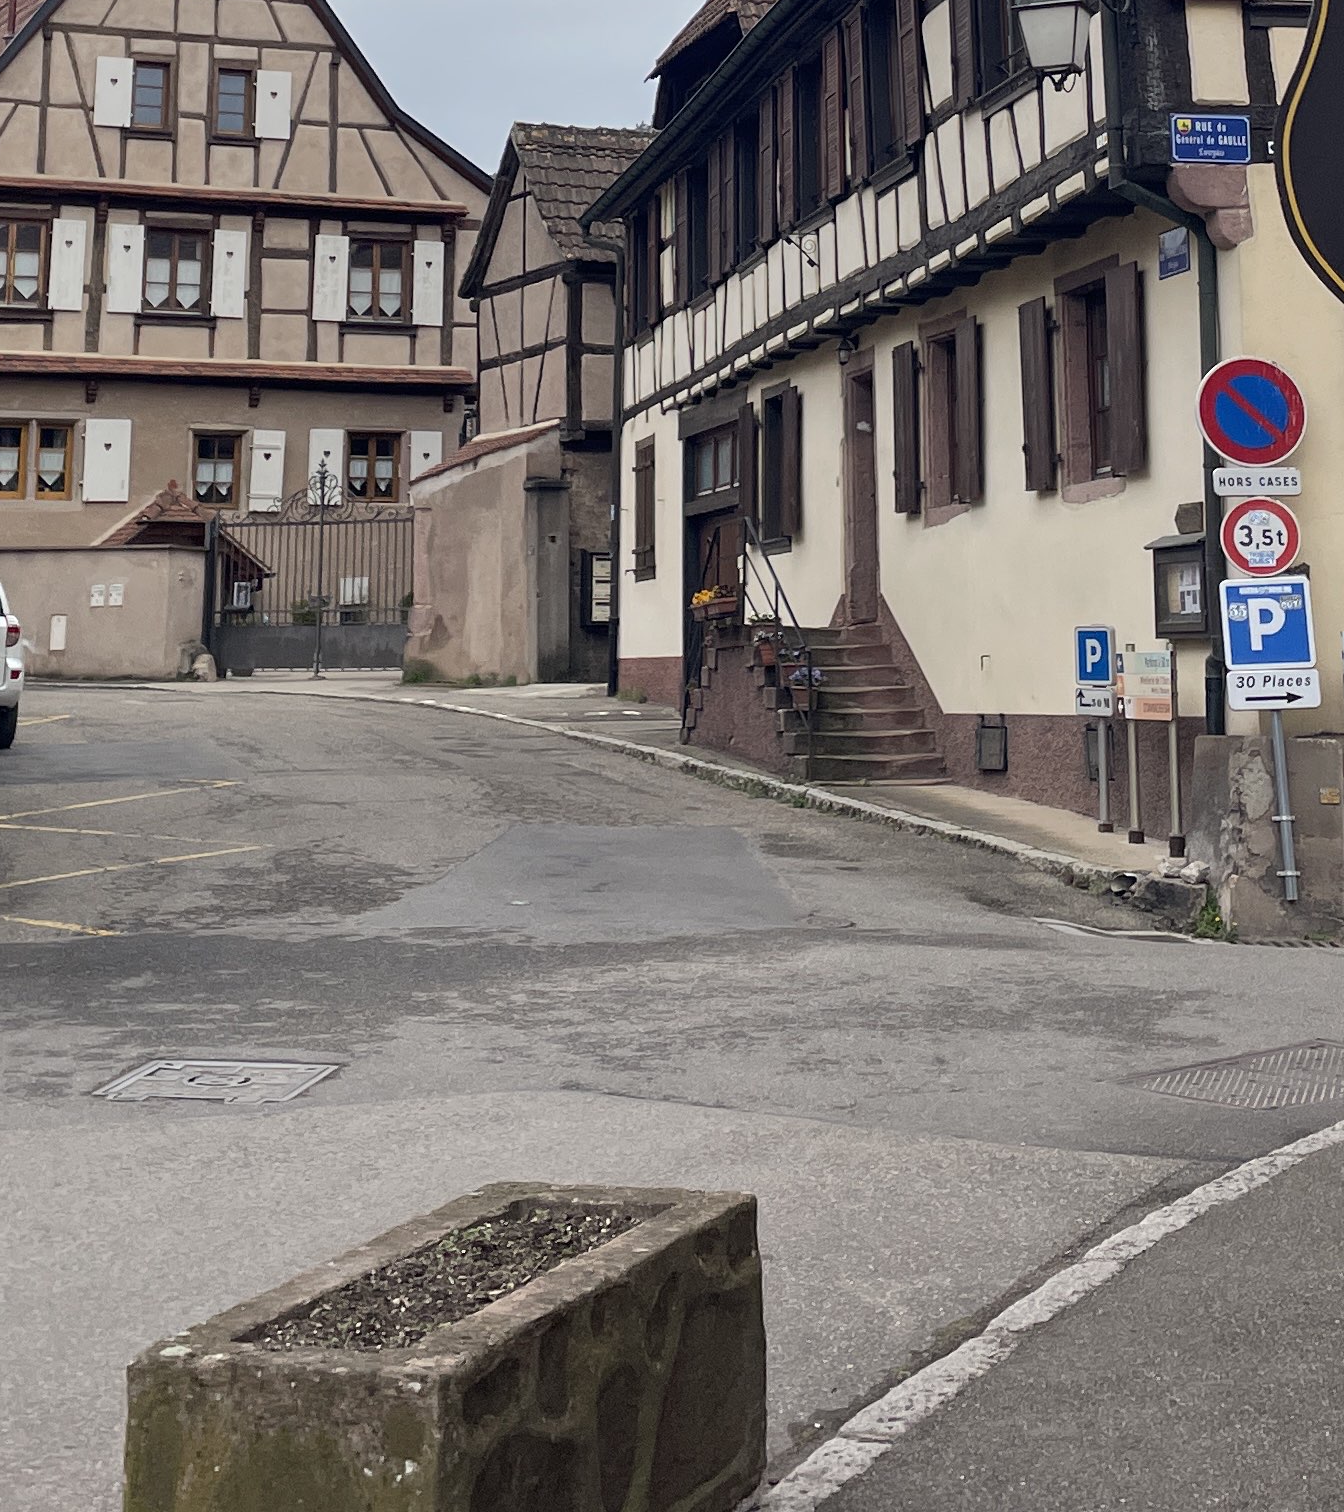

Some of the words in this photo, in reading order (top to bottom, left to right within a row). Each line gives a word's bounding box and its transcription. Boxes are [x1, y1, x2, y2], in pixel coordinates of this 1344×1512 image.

[1195, 121, 1213, 132] RUE
[1175, 133, 1204, 145] Général
[1206, 134, 1215, 145] de
[1218, 135, 1247, 147] GAULLE
[1219, 477, 1252, 487] HORS
[1259, 476, 1298, 487] CASES
[1246, 597, 1287, 652] P
[1085, 638, 1102, 673] P
[1236, 676, 1256, 688] 30
[1263, 675, 1312, 688] Places
